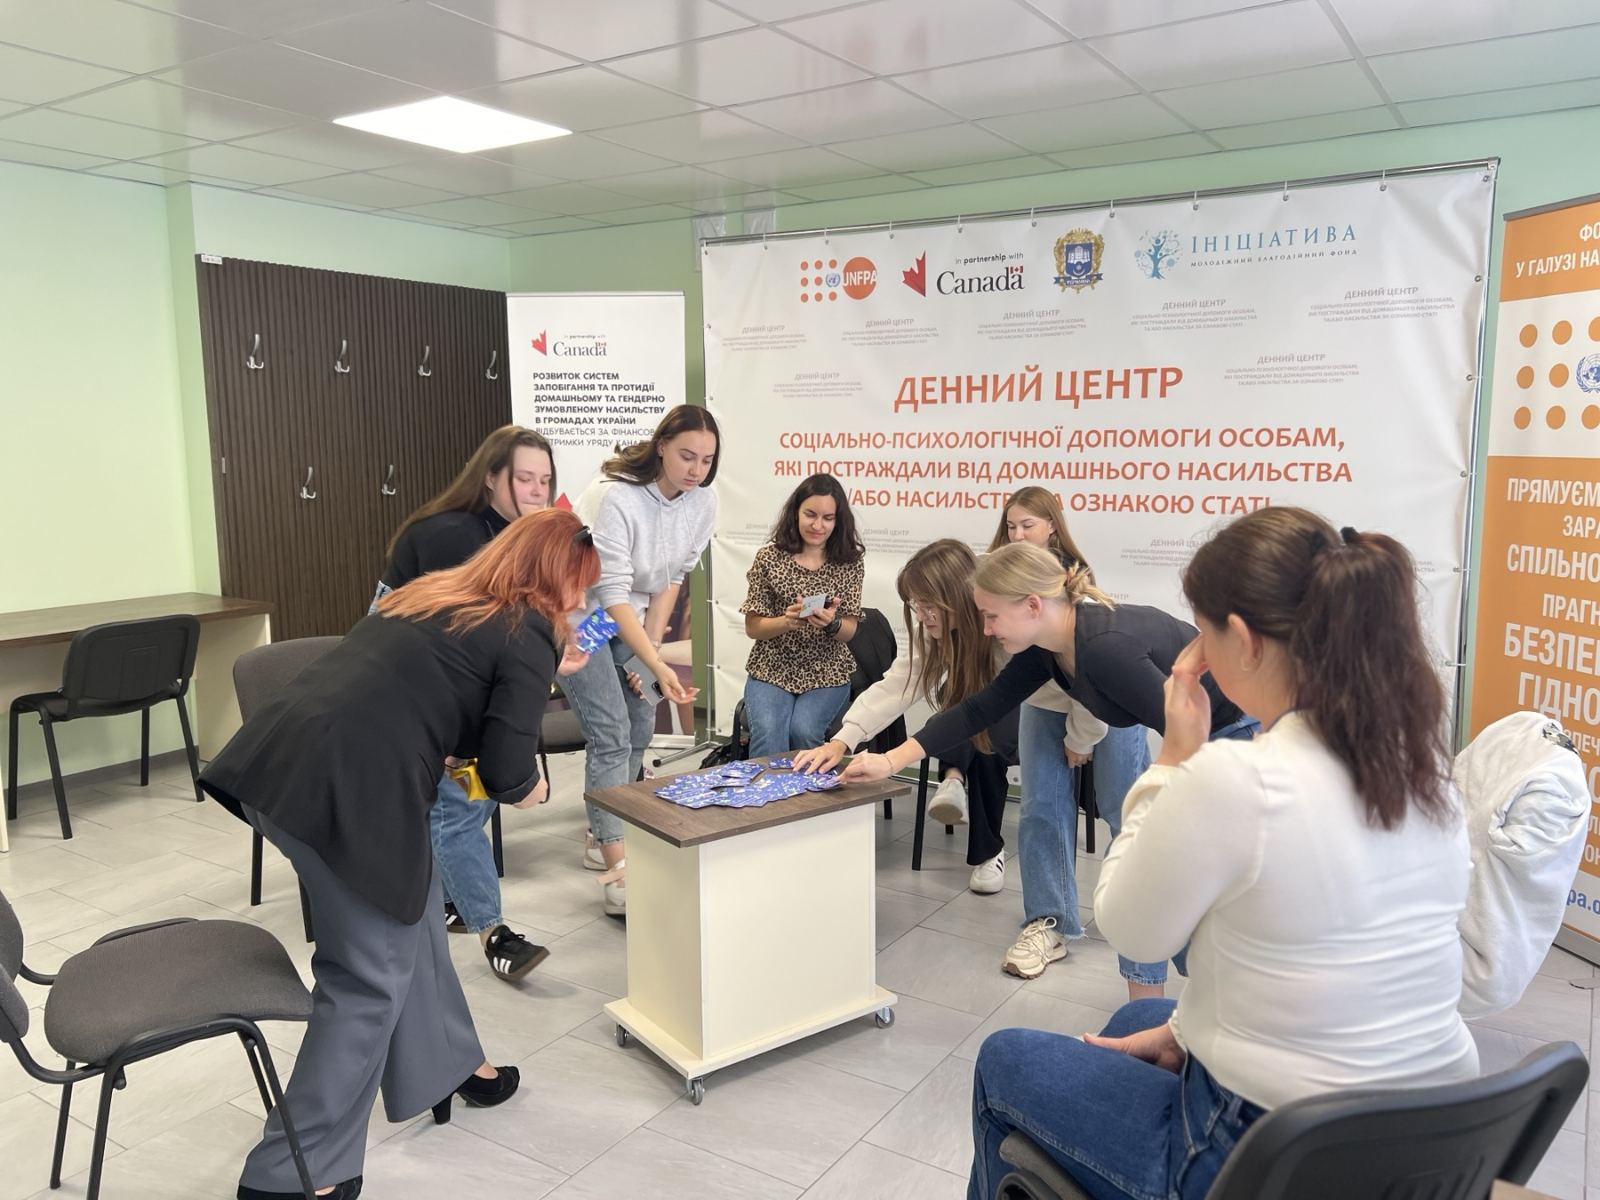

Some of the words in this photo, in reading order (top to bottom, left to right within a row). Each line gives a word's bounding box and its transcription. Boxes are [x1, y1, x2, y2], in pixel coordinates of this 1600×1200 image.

[1191, 224, 1356, 253] ІНІЦІАТИВА
[964, 253, 1006, 265] partnership
[1008, 252, 1024, 261] with
[1516, 262, 1524, 278] У
[1528, 252, 1576, 276] ГАЛУЗІ
[1580, 249, 1600, 268] НА
[936, 267, 1025, 296] Canada
[1387, 286, 1418, 296] ЦЕНТР
[553, 341, 608, 357] Canada
[533, 372, 581, 380] РОЗВИТОК
[583, 372, 620, 380] СИСТЕМ
[534, 383, 596, 392] ЗАПОБІГАННЯ
[598, 384, 609, 392] ТА
[611, 382, 656, 392] ПРОТИДІЇ
[894, 364, 1042, 413] ДЕННИЙ
[1054, 366, 1184, 410] ЦЕНТР
[534, 394, 602, 404] ДОМАШНЬОМУ
[604, 394, 616, 402] ТА
[618, 395, 666, 404] ГЕНДЕРНО
[534, 406, 604, 414] ЗУМОВЛЕНОМУ
[606, 406, 666, 414] НАСИЛЬСТВУ
[536, 416, 541, 424] В
[543, 416, 595, 426] ГРОМАДАХ
[596, 415, 636, 424] УКРАЇНИ
[599, 428, 608, 436] ЗА
[780, 425, 1062, 453] СОЦІАЛЬНО-ПСИХОЛОГІЧНОЇ
[1067, 428, 1211, 452] ДОПОМОГИ
[1218, 427, 1346, 452] ОСОБАМ,
[548, 439, 584, 447] ТРИМКИ
[586, 440, 613, 448] УРЯДУ
[774, 460, 802, 477] ЯКІ
[806, 460, 950, 484] ПОСТРАЖДАЛИ
[958, 462, 992, 484] ВІД
[996, 461, 1171, 484] ДОМАШНЬОГО
[1178, 462, 1353, 483] НАСИЛЬСТВА
[1507, 478, 1600, 508] ПРЯМУЄМ
[1070, 493, 1194, 514] ОЗНАКОЮ
[1506, 544, 1600, 584] СПІЛЬНО
[1517, 671, 1600, 726] ГІДНО
